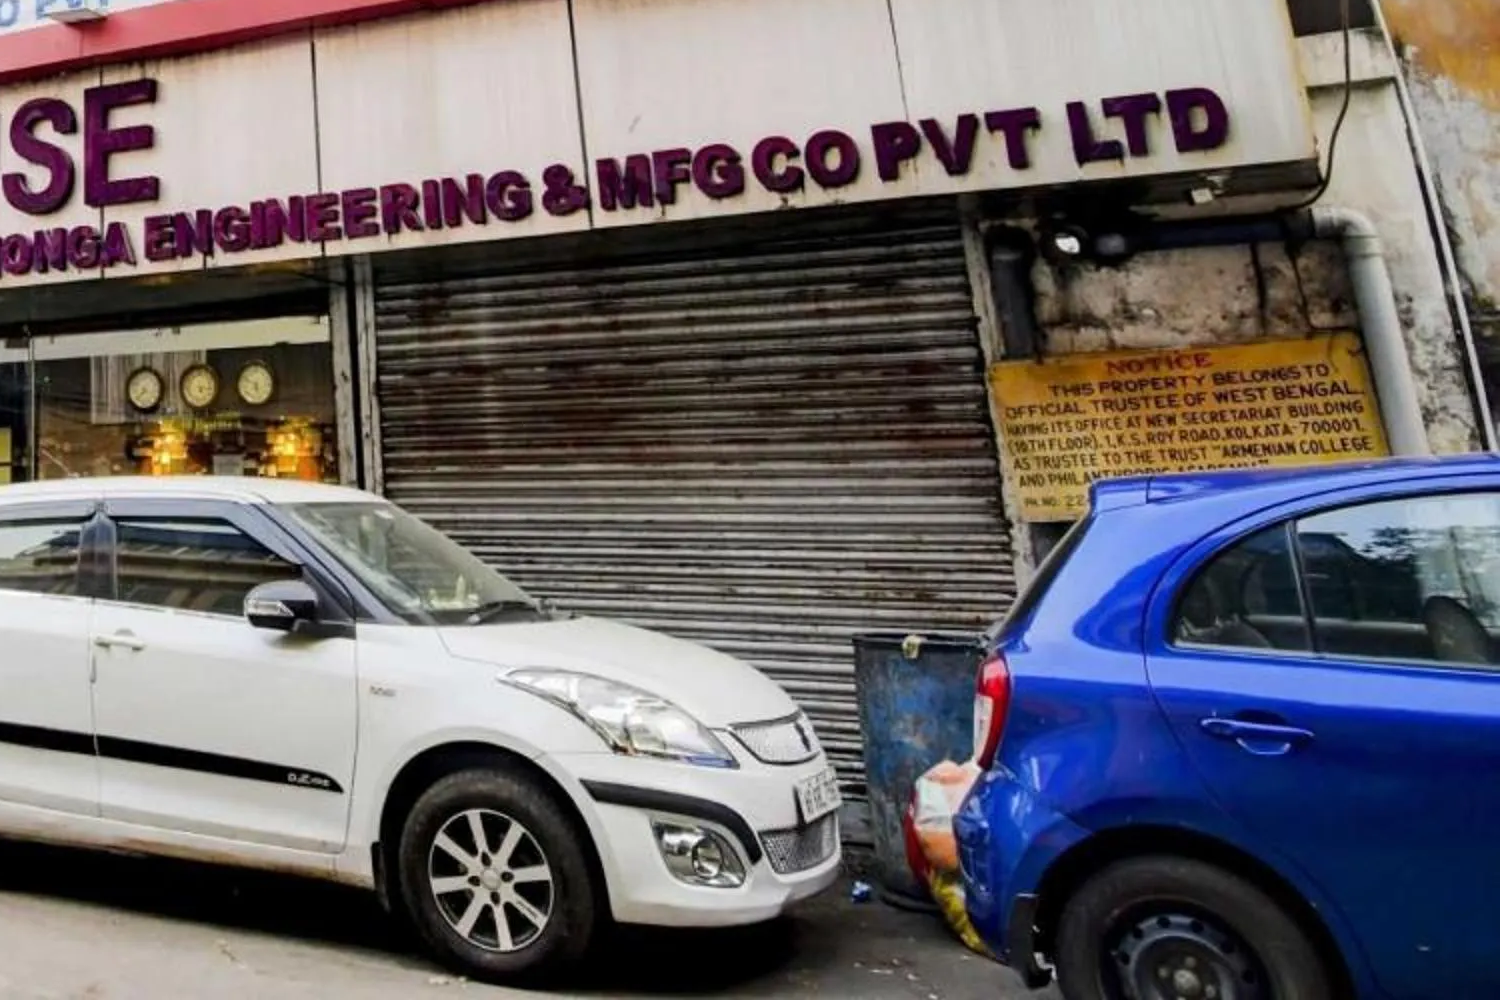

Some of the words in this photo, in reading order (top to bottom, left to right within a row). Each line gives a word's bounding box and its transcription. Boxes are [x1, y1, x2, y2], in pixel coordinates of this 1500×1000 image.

[143, 168, 535, 262] ENGINEERING
[540, 163, 590, 217] &
[595, 144, 746, 213] MFG
[751, 128, 862, 194] CO
[870, 107, 1041, 182] PVT
[1064, 86, 1231, 165] LTD
[1048, 383, 1095, 397] THIS
[1099, 376, 1206, 395] PROPERTY
[1212, 366, 1301, 386] BELONGS
[1303, 364, 1330, 379] TO
[1105, 352, 1214, 375] NOTICE
[1005, 403, 1087, 420] OFFICIAL
[1090, 394, 1181, 414] TRUSTEE
[1183, 392, 1208, 407] OF
[1213, 386, 1270, 404] WEST
[1006, 423, 1049, 437] HAVING
[1050, 421, 1073, 434] ITS
[1075, 417, 1122, 432] OFFICE
[1126, 416, 1142, 429] AT
[1146, 414, 1177, 428] NEW
[1182, 406, 1282, 425] SECRETARIAT
[1288, 400, 1365, 419] BUILDING
[1013, 458, 1031, 471] AS
[1035, 454, 1099, 469] TRUSTEE
[1102, 452, 1122, 465] TO
[1125, 451, 1155, 463] THE
[1159, 448, 1208, 464] TRUST
[1300, 436, 1373, 455] COLLEGE
[1019, 475, 1045, 488] AND
